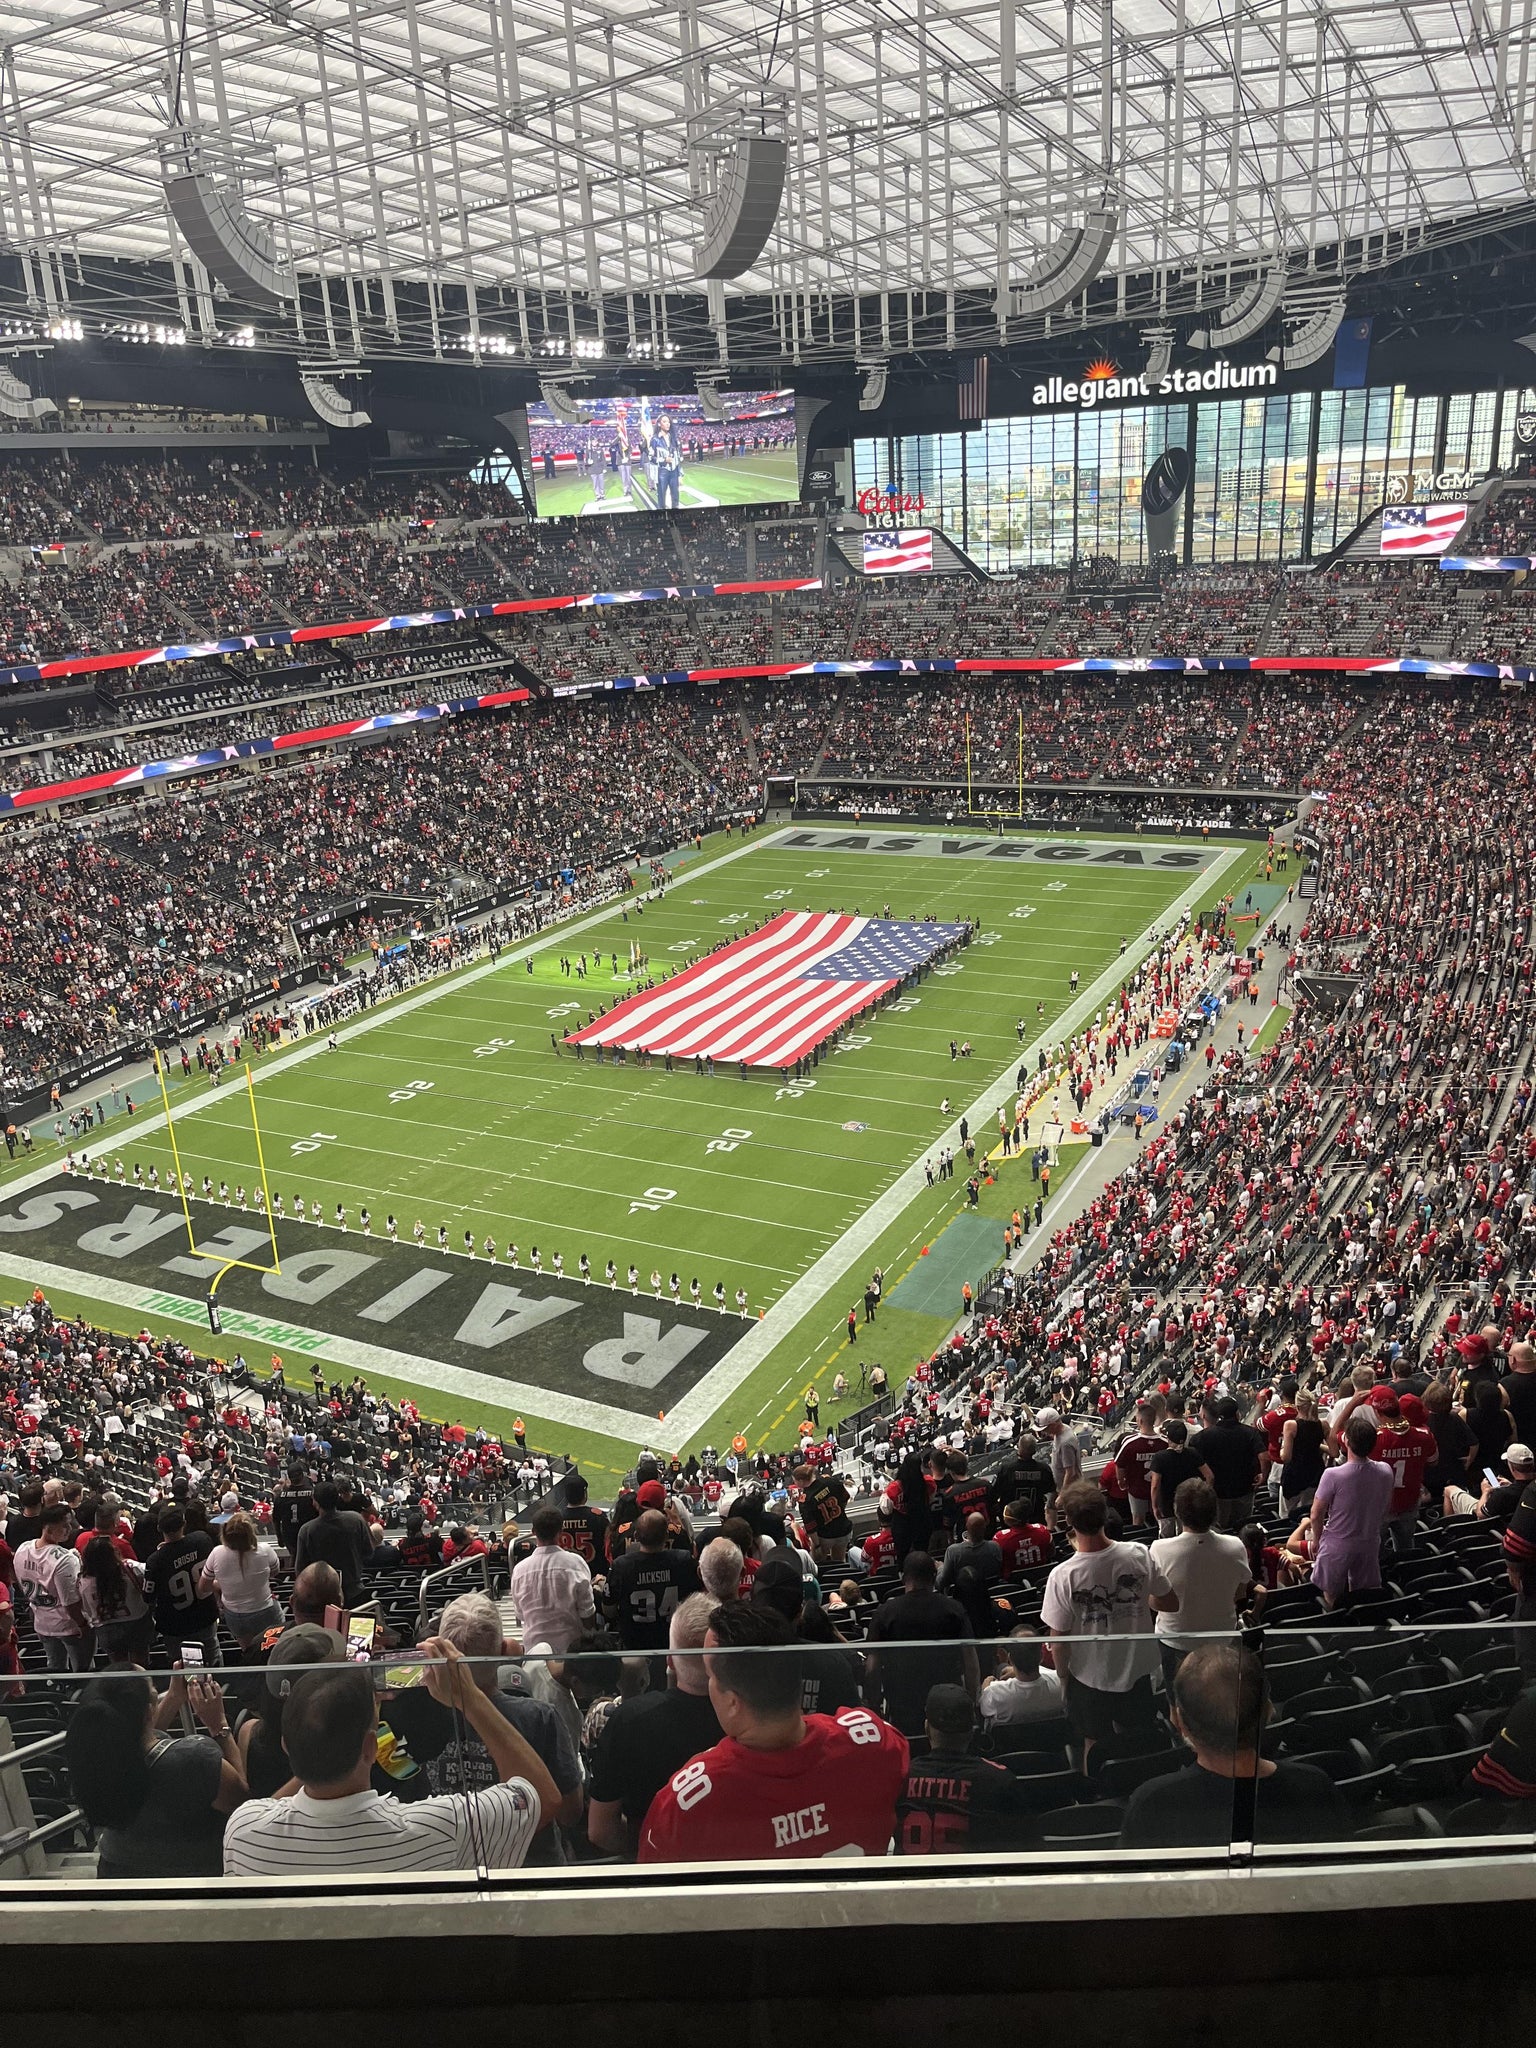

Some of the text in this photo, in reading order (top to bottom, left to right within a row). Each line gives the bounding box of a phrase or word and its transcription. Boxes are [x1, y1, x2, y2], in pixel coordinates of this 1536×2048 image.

[1032, 361, 1277, 407] allegiant stadium
[1417, 473, 1471, 491] MGM
[858, 487, 927, 515] Coors
[865, 514, 917, 529] LIGHT
[783, 834, 1204, 867] LAS VEGAS
[805, 868, 830, 877] 10
[763, 888, 792, 899] 20
[718, 912, 748, 924] 30
[1008, 905, 1036, 918] 20
[972, 933, 1002, 946] 30
[546, 1001, 581, 1016] 40
[886, 997, 921, 1012] 50
[472, 1037, 516, 1056] 30
[837, 1035, 872, 1052] 40
[81, 1071, 90, 1079] LAS
[90, 1065, 105, 1075] VEGAS
[388, 1080, 435, 1101] 20
[776, 1078, 818, 1099] 30
[290, 1132, 338, 1153] 10
[706, 1128, 754, 1152] 20
[629, 1186, 678, 1212] 10
[0, 1189, 711, 1389] RAIDERS
[260, 1324, 332, 1351] PLAY
[1381, 1447, 1411, 1458] SAMUEL
[1392, 1460, 1406, 1488] 1
[814, 1487, 830, 1501] PURDY
[290, 1503, 298, 1523] 1
[817, 1496, 841, 1525] 13
[558, 1531, 596, 1563] 85
[173, 1550, 199, 1569] CROSBY
[636, 1569, 671, 1585] JACKSON
[630, 1585, 679, 1623] 34
[802, 1694, 818, 1709] RE
[836, 1710, 882, 1745] 80
[446, 1760, 493, 1774] Knvas
[446, 1773, 457, 1784] by
[671, 1761, 713, 1811] 80
[906, 1776, 972, 1802] KITTLE
[771, 1803, 830, 1849] RICE
